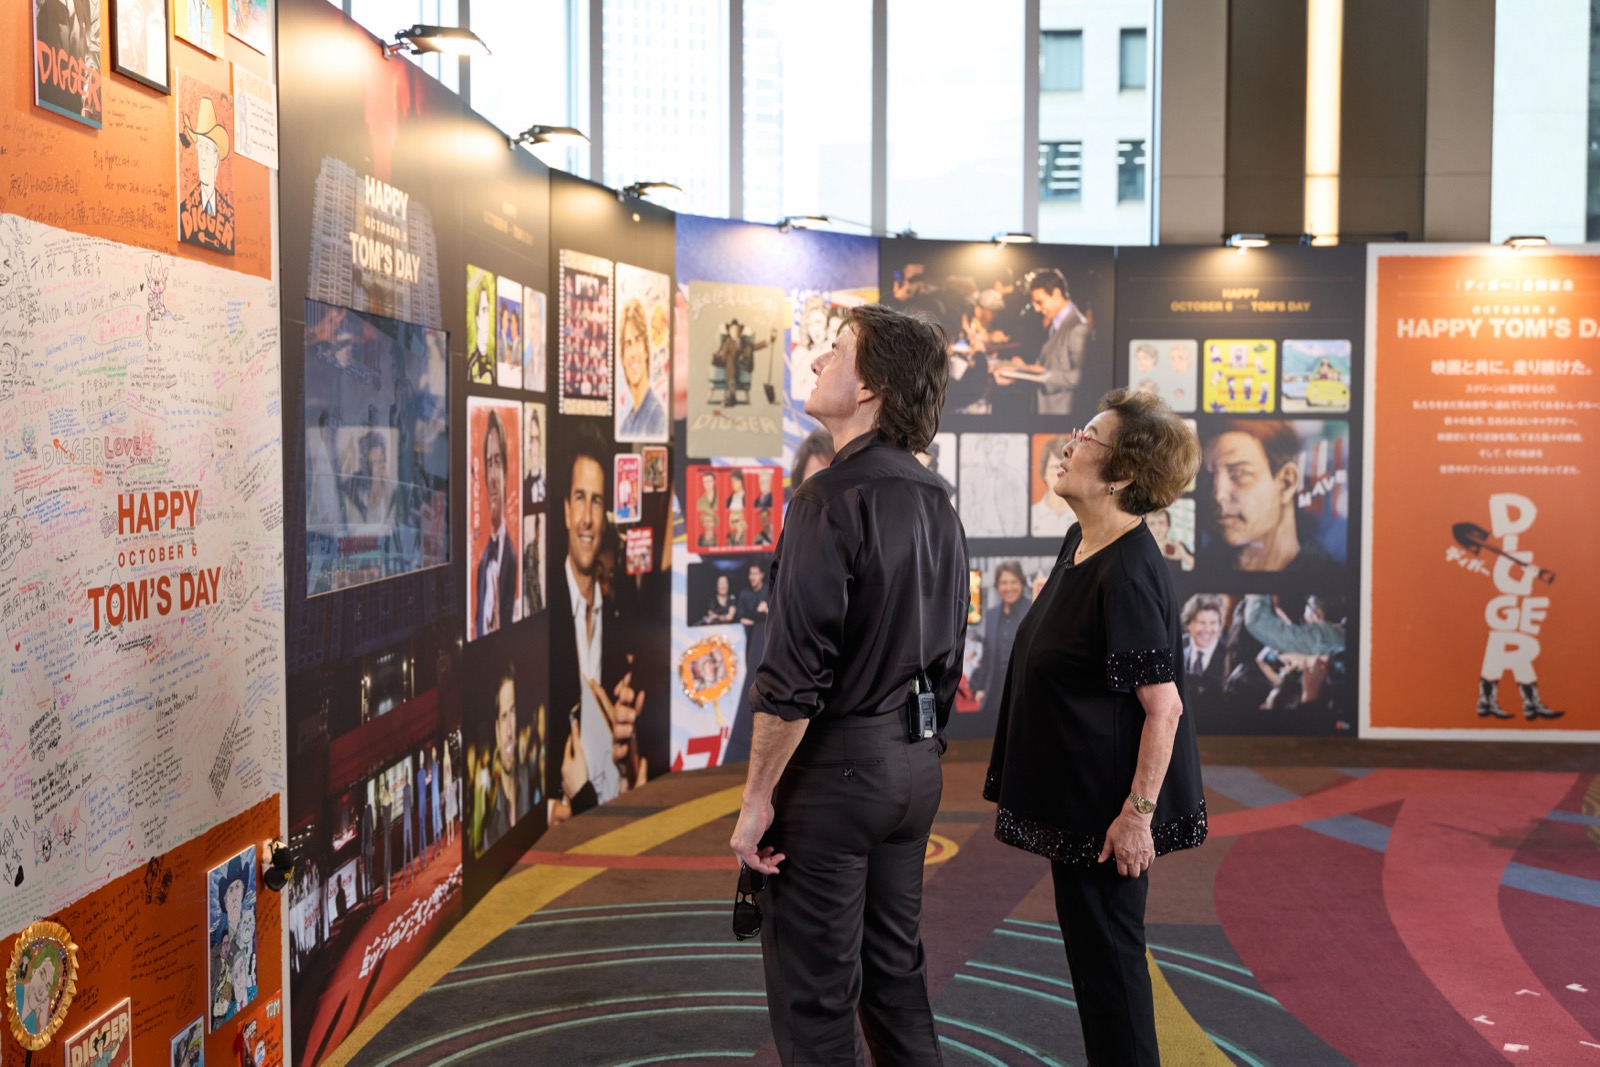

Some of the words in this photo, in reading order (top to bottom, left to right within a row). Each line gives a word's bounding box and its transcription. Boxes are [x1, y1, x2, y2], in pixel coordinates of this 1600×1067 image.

[37, 40, 101, 111] DIGGER
[365, 174, 409, 221] HAPPY
[181, 205, 234, 250] DIGGER
[350, 232, 393, 275] TOM'S
[395, 249, 420, 284] DAY
[1288, 301, 1311, 312] DAY
[1397, 318, 1481, 338] HAPPY
[1489, 318, 1572, 338] TOM'S
[1472, 305, 1540, 315] OCTOBER
[42, 437, 104, 470] DIGGER
[104, 435, 142, 459] LOVE
[118, 490, 199, 535] HAPPY
[118, 545, 183, 569] OCTOBER
[191, 543, 198, 557] 6
[88, 575, 172, 630] TOM'S
[180, 567, 221, 611] DAY
